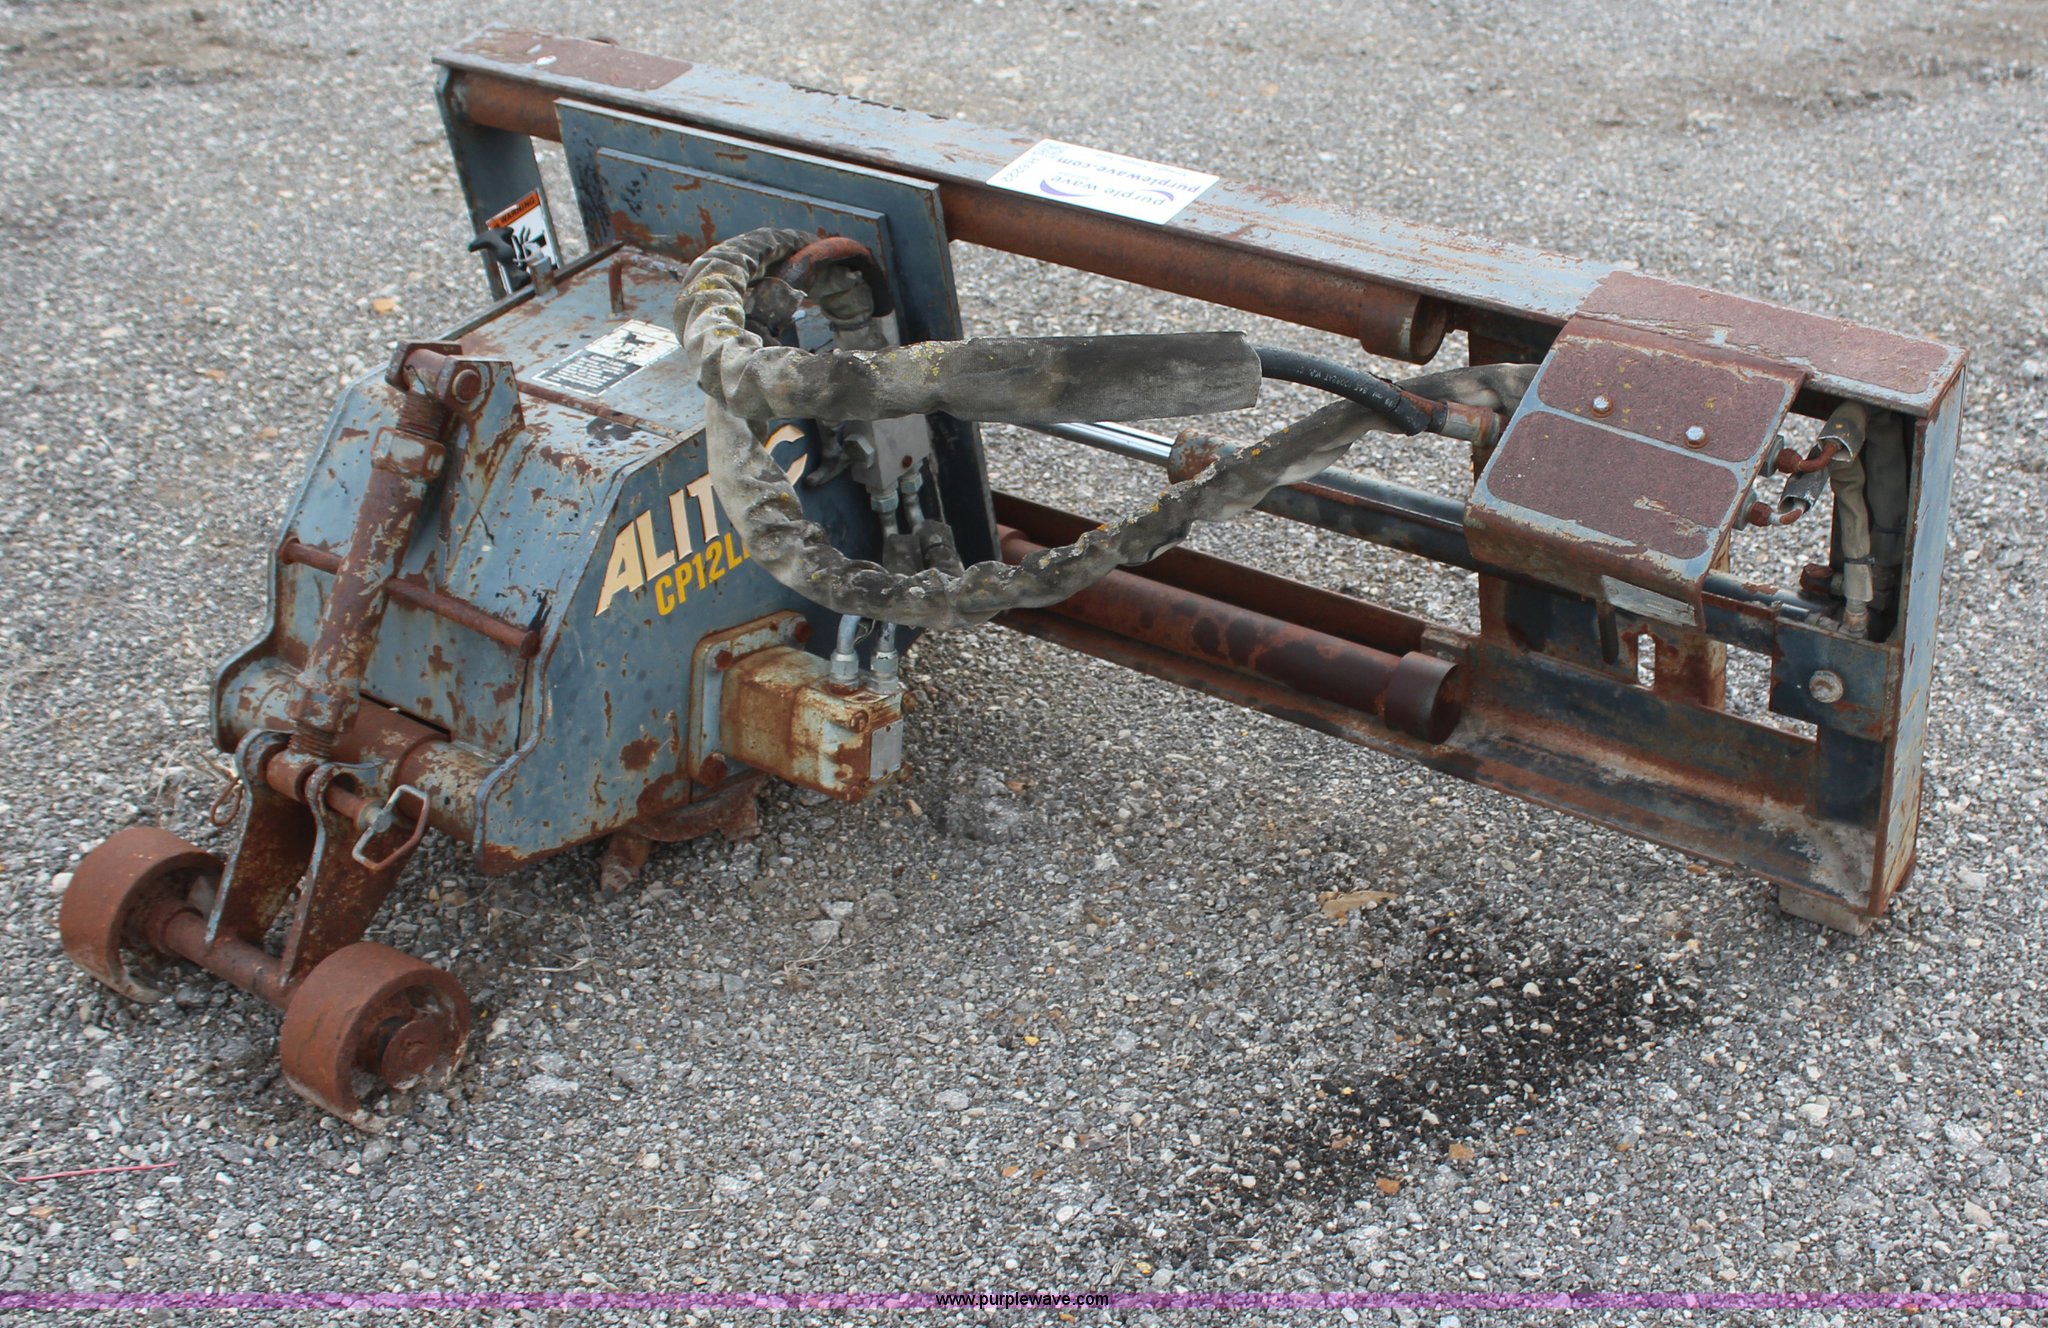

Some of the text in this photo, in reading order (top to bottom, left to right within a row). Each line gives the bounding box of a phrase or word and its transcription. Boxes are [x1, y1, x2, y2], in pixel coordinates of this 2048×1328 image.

[1050, 174, 1098, 192] wave
[1057, 157, 1201, 194] purplewave.com
[1104, 186, 1167, 207] purple
[654, 532, 751, 617] CP12L
